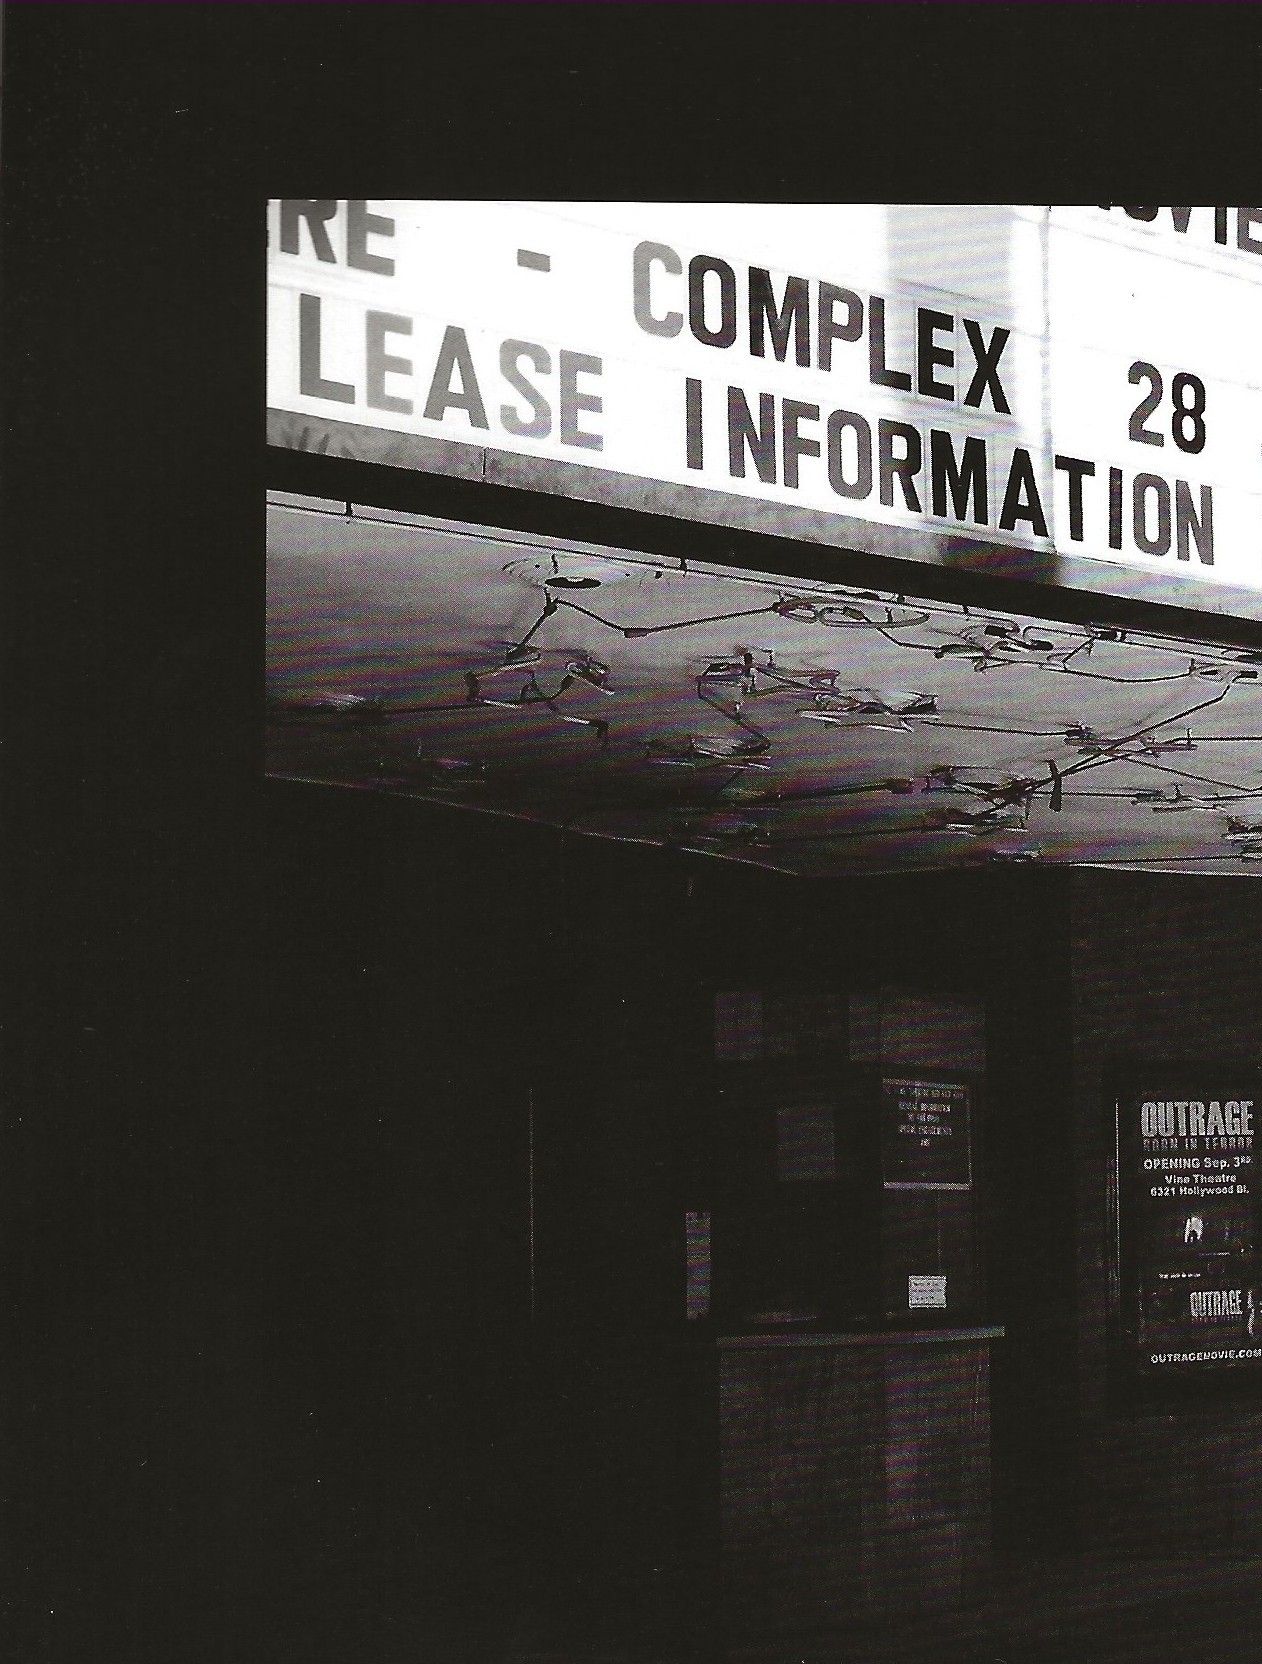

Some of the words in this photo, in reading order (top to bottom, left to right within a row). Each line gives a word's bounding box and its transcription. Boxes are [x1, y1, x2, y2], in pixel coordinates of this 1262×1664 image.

[632, 240, 1012, 415] COMPLEX
[1127, 360, 1206, 454] 28
[300, 293, 603, 452] LEASE
[685, 377, 1215, 566] INFORMATION
[1141, 1100, 1255, 1137] OUTRAGE
[1143, 1157, 1201, 1170] OPENING
[1203, 1157, 1230, 1170] Sep.
[1164, 1174, 1190, 1185] Vine
[1192, 1173, 1237, 1185] Theatre
[1150, 1186, 1176, 1198] 6321
[1179, 1185, 1234, 1198] Hollywood
[1190, 1290, 1243, 1317] OUTRAGE
[1150, 1348, 1262, 1364] OUTRAGEMOVIE.COM
